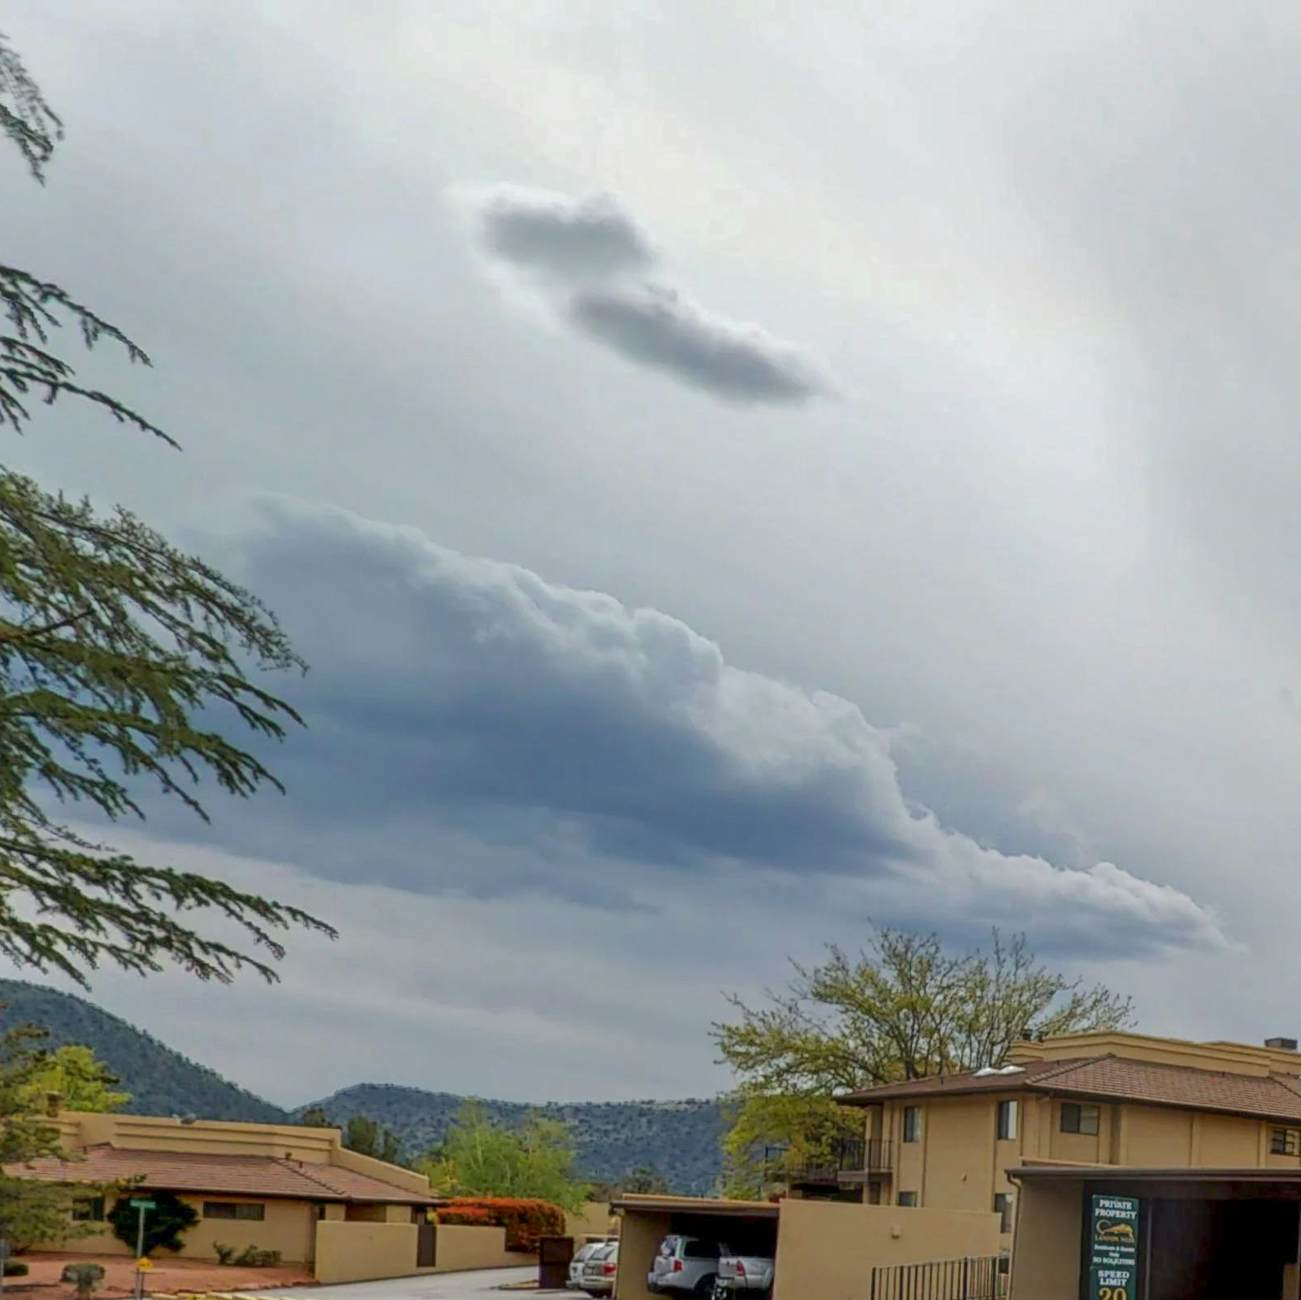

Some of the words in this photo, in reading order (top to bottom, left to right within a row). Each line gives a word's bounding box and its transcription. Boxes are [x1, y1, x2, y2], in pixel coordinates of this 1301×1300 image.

[1099, 1199, 1132, 1210] PRIVATE
[1095, 1208, 1137, 1219] PROPERTY
[1098, 1270, 1129, 1278] SPEED
[1099, 1278, 1127, 1286] LIMIT
